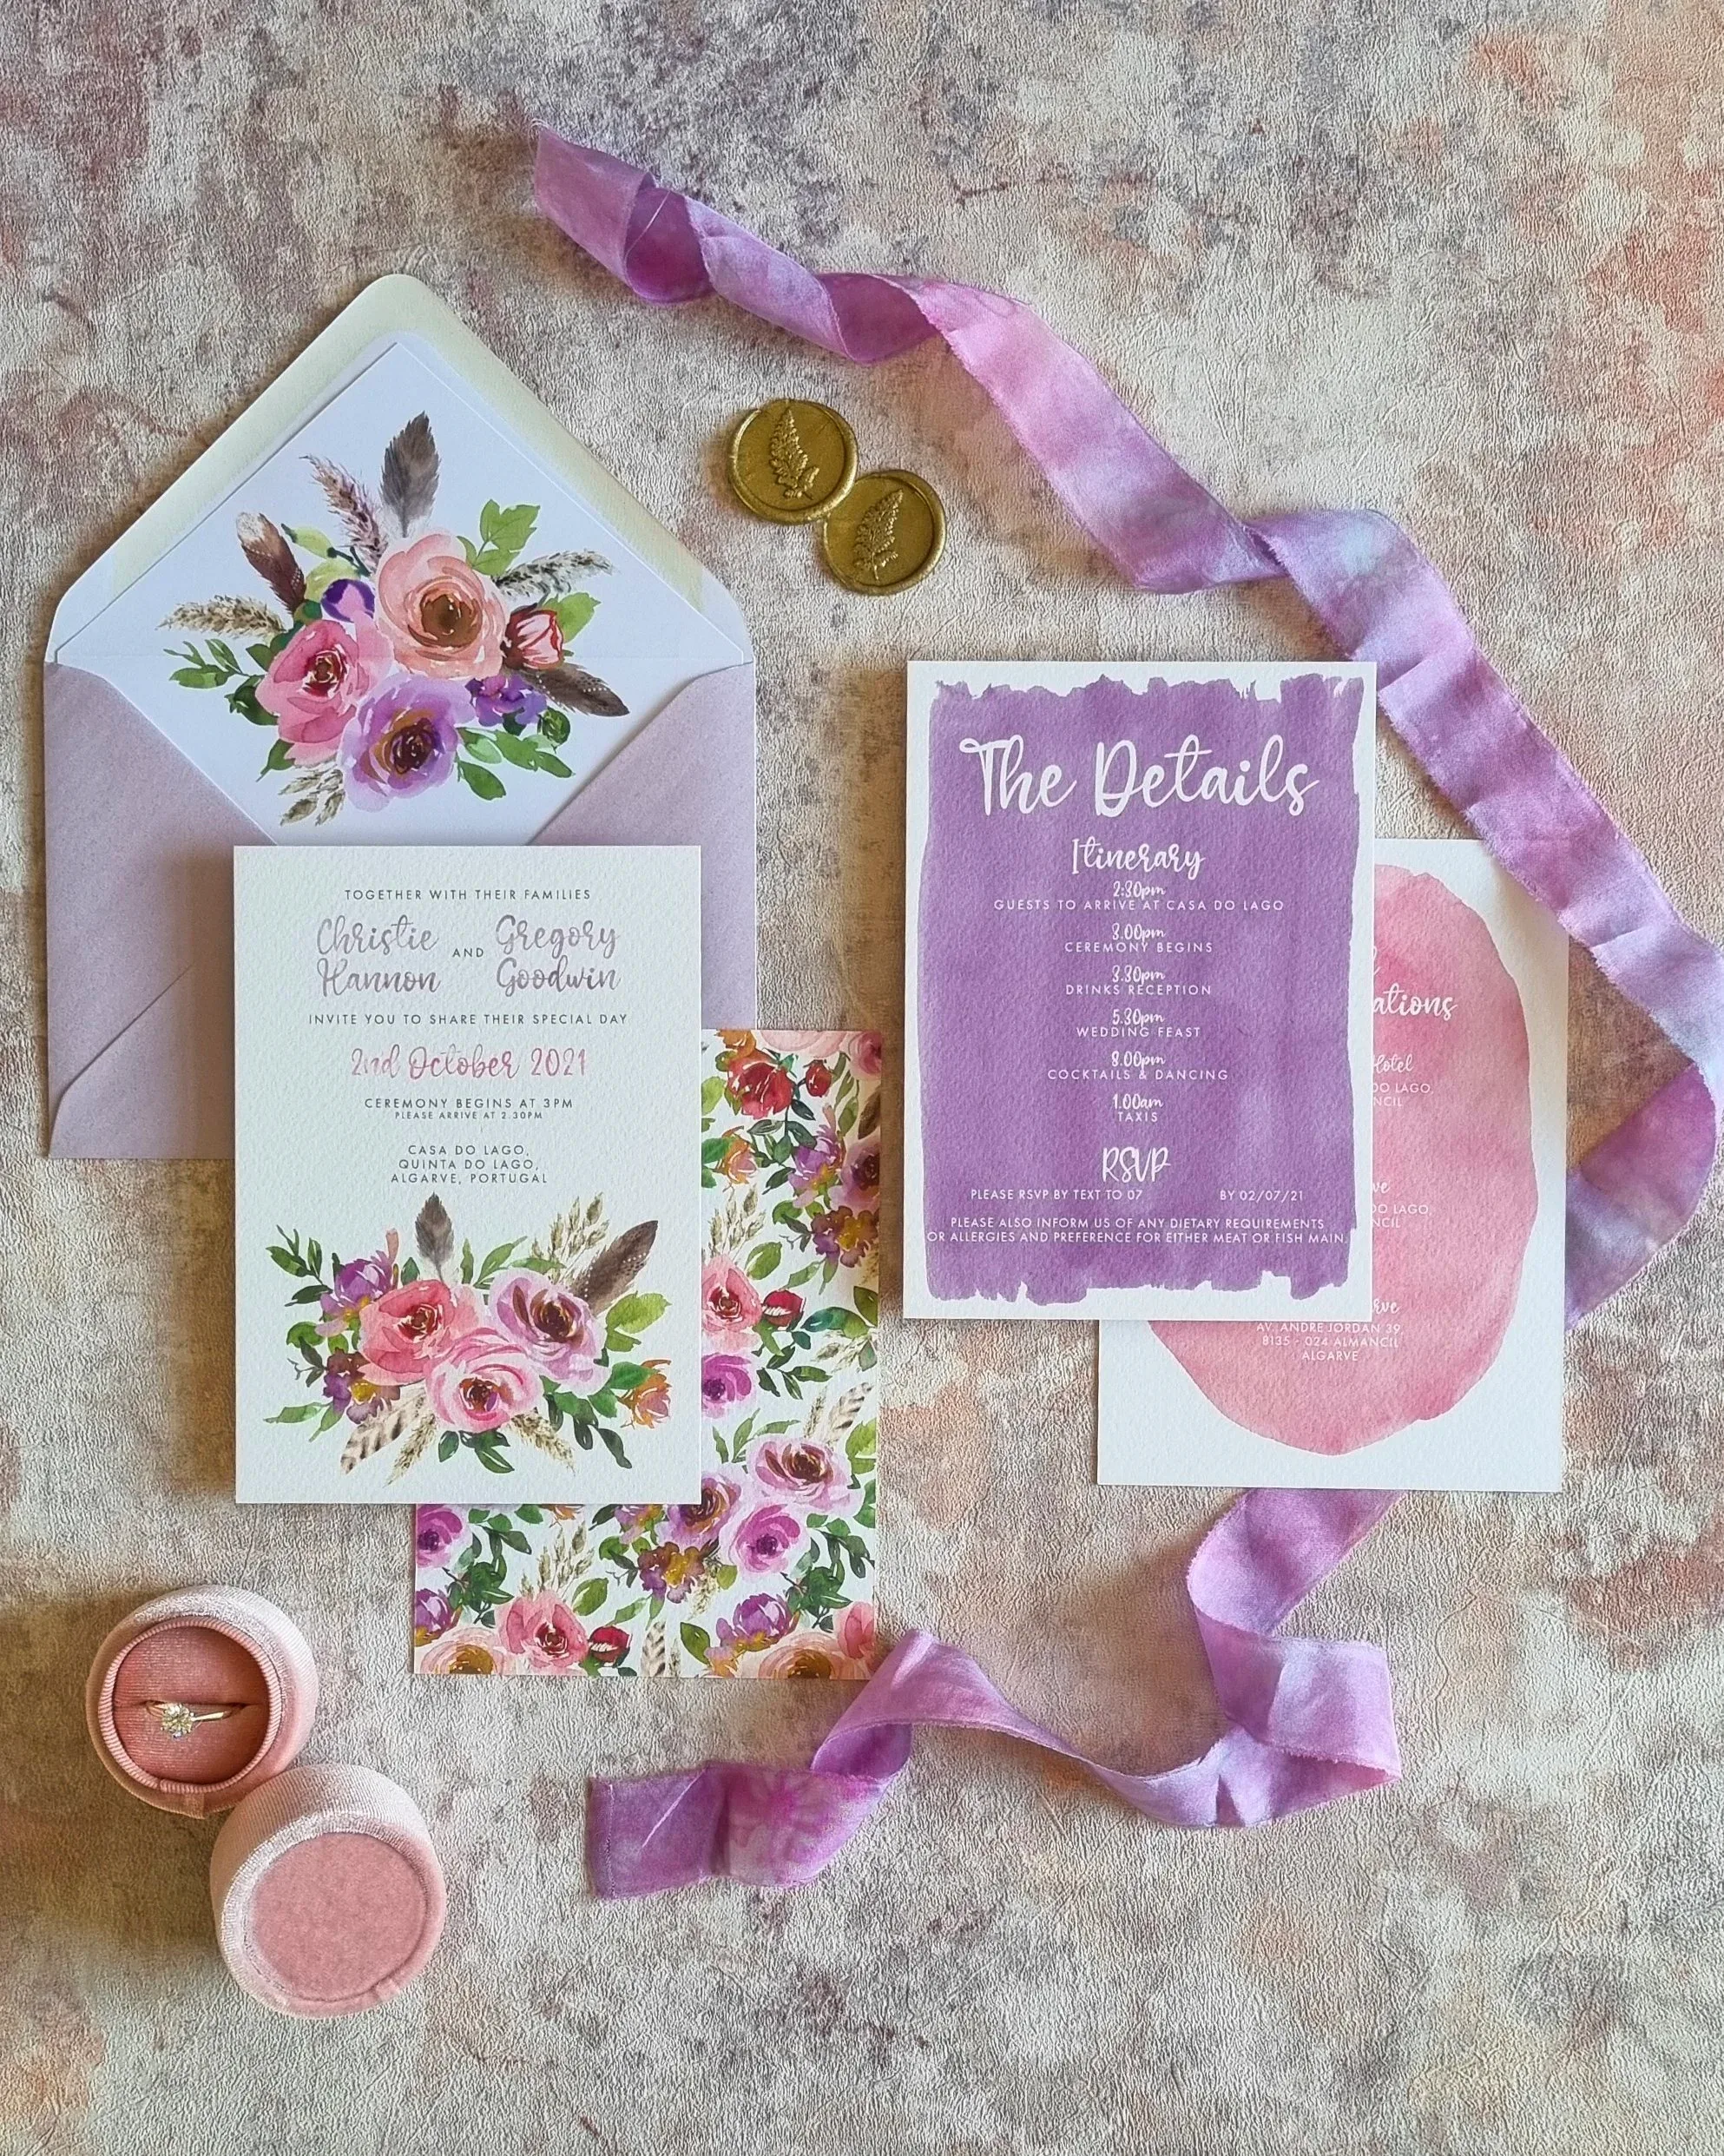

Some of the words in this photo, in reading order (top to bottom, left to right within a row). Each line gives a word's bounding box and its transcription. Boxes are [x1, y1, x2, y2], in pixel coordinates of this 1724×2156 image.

[959, 735, 1077, 816] The
[1095, 734, 1320, 817] Details
[1071, 835, 1206, 880] Itinerary
[345, 889, 422, 900] TOGETHER
[430, 889, 467, 900] WITH
[476, 889, 516, 900] THEIR
[524, 889, 590, 900] FAMILIES
[1113, 880, 1166, 900] 2:30pm
[994, 900, 1050, 911] GUESTS
[1058, 900, 1076, 911] TO
[1084, 900, 1135, 911] ARRIVE
[1142, 900, 1160, 911] AT
[1167, 900, 1207, 911] CASA
[1214, 900, 1235, 911] DO
[1243, 900, 1284, 911] LAGO
[317, 914, 439, 955] Christie
[452, 947, 484, 958] AND
[495, 914, 620, 959] Gregory
[1112, 923, 1166, 942] 3.00pm
[1064, 942, 1148, 953] CEREMONY
[1156, 942, 1213, 953] BEGINS
[317, 958, 442, 997] Hannon
[497, 955, 621, 997] Goodwin
[1112, 965, 1165, 985] 3.30pm
[1066, 985, 1120, 995] DRINKS
[1128, 985, 1211, 995] RECEPTION
[1373, 982, 1458, 1021] ations
[308, 1014, 358, 1025] INVITE
[365, 1014, 396, 1025] YOU
[404, 1014, 422, 1025] TO
[430, 1014, 477, 1025] SHARE
[484, 1014, 525, 1025] THEIR
[532, 1014, 592, 1025] SPECIAL
[600, 1014, 628, 1025] DAY
[1112, 1007, 1165, 1026] 5.30pm
[1076, 1027, 1149, 1038] WEDDING
[1158, 1027, 1201, 1038] FEAST
[352, 1044, 400, 1078] 2nd
[408, 1043, 520, 1079] October
[531, 1047, 586, 1077] 2021
[1111, 1051, 1166, 1069] 8.00pm
[1048, 1070, 1130, 1080] COCKTAILS
[1138, 1070, 1147, 1080] &
[1155, 1070, 1228, 1080] DANCING
[365, 1098, 448, 1109] CEREMONY
[456, 1098, 512, 1109] BEGINS
[519, 1098, 536, 1109] AT
[543, 1098, 573, 1109] 3PM
[1112, 1093, 1163, 1110] 1.00am
[1373, 1096, 1403, 1107] NCIL
[395, 1111, 434, 1120] PLEASE
[438, 1111, 477, 1120] ARRIVE
[483, 1111, 496, 1120] AT
[501, 1111, 543, 1120] 2.30PM
[1117, 1111, 1158, 1122] TAXIS
[408, 1144, 447, 1156] CASA
[455, 1144, 476, 1156] DO
[484, 1144, 530, 1157] LAGO,
[398, 1159, 457, 1170] QUINTA
[464, 1159, 485, 1170] DO
[493, 1159, 539, 1171] LAGO,
[1102, 1146, 1171, 1183] RSVP
[391, 1173, 462, 1185] ALGARVE,
[470, 1173, 548, 1184] PORTUGAL
[971, 1189, 1014, 1200] PLEASE
[1019, 1189, 1049, 1200] RSVP
[1054, 1189, 1069, 1200] BY
[1073, 1189, 1101, 1200] TEXT
[1106, 1189, 1122, 1200] TO
[1128, 1189, 1143, 1200] 07
[1220, 1190, 1235, 1201] BY
[1240, 1190, 1303, 1203] 02/07/21
[951, 1217, 994, 1229] PLEASE
[999, 1217, 1032, 1229] ALSO
[1037, 1217, 1089, 1229] INFORM
[1094, 1217, 1110, 1229] US
[1115, 1217, 1133, 1229] OF
[1138, 1217, 1165, 1229] ANY
[1170, 1218, 1221, 1230] DIETARY
[1226, 1218, 1324, 1230] REQUIREMENTS
[1372, 1217, 1401, 1228] NCIL
[927, 1231, 945, 1243] OR
[950, 1231, 1016, 1243] ALLERGIES
[1020, 1231, 1049, 1243] AND
[1054, 1231, 1131, 1243] PREFERENCE
[1136, 1231, 1161, 1243] FOR
[1167, 1232, 1208, 1243] EITHER
[1214, 1232, 1247, 1243] MEAT
[1252, 1232, 1270, 1243] OR
[1275, 1232, 1302, 1243] FISH
[1280, 1322, 1323, 1333] ANDRE
[1327, 1323, 1380, 1334] JORDAN
[1262, 1335, 1290, 1346] 8135
[1305, 1336, 1328, 1346] 024
[1333, 1336, 1398, 1348] ALMANCIL
[1301, 1350, 1359, 1362] ALGARVE
